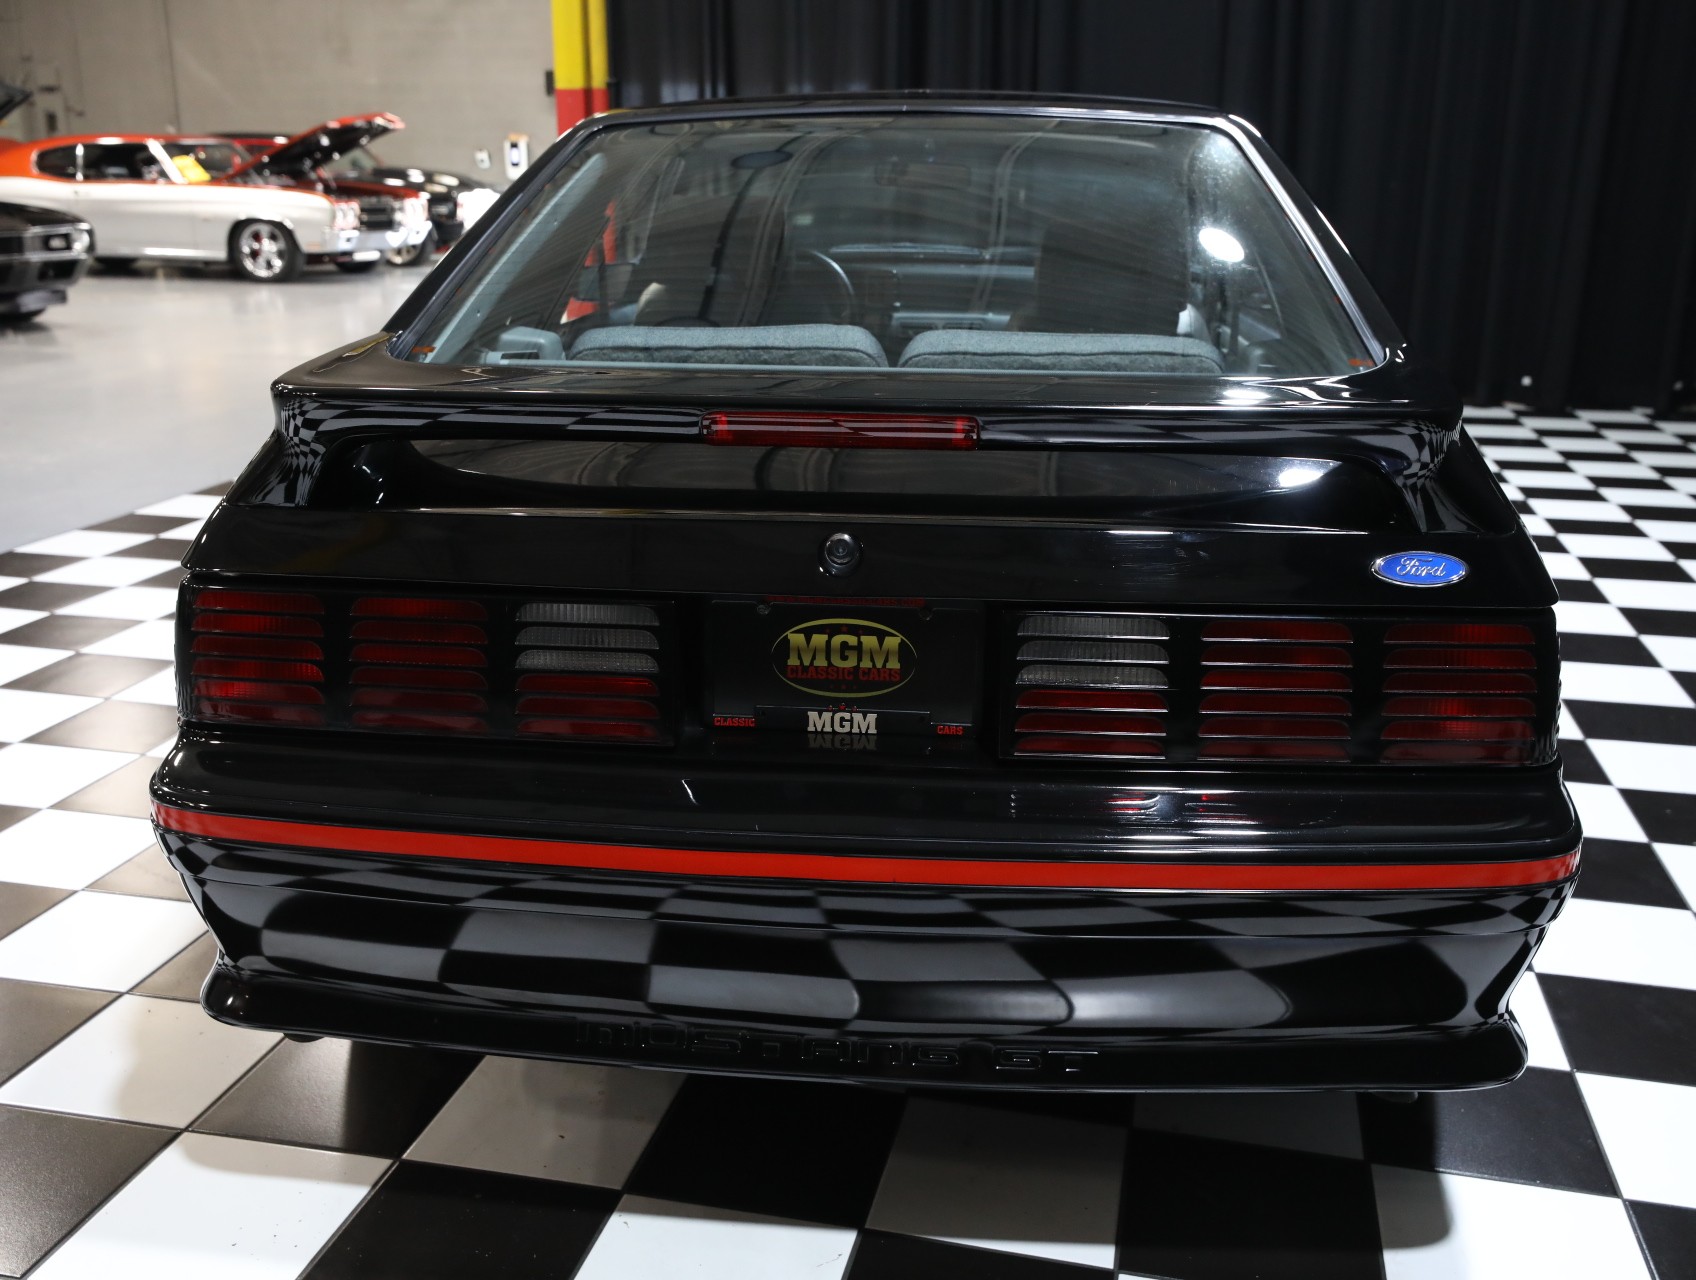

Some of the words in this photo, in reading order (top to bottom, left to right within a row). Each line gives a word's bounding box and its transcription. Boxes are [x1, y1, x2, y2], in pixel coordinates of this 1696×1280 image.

[1396, 557, 1446, 577] Ford
[787, 633, 902, 669] MGM
[786, 664, 853, 680] CLASSIC
[859, 667, 901, 682] CARS
[713, 717, 756, 727] CLASSIC
[807, 711, 878, 734] MGM
[936, 725, 963, 735] CARS
